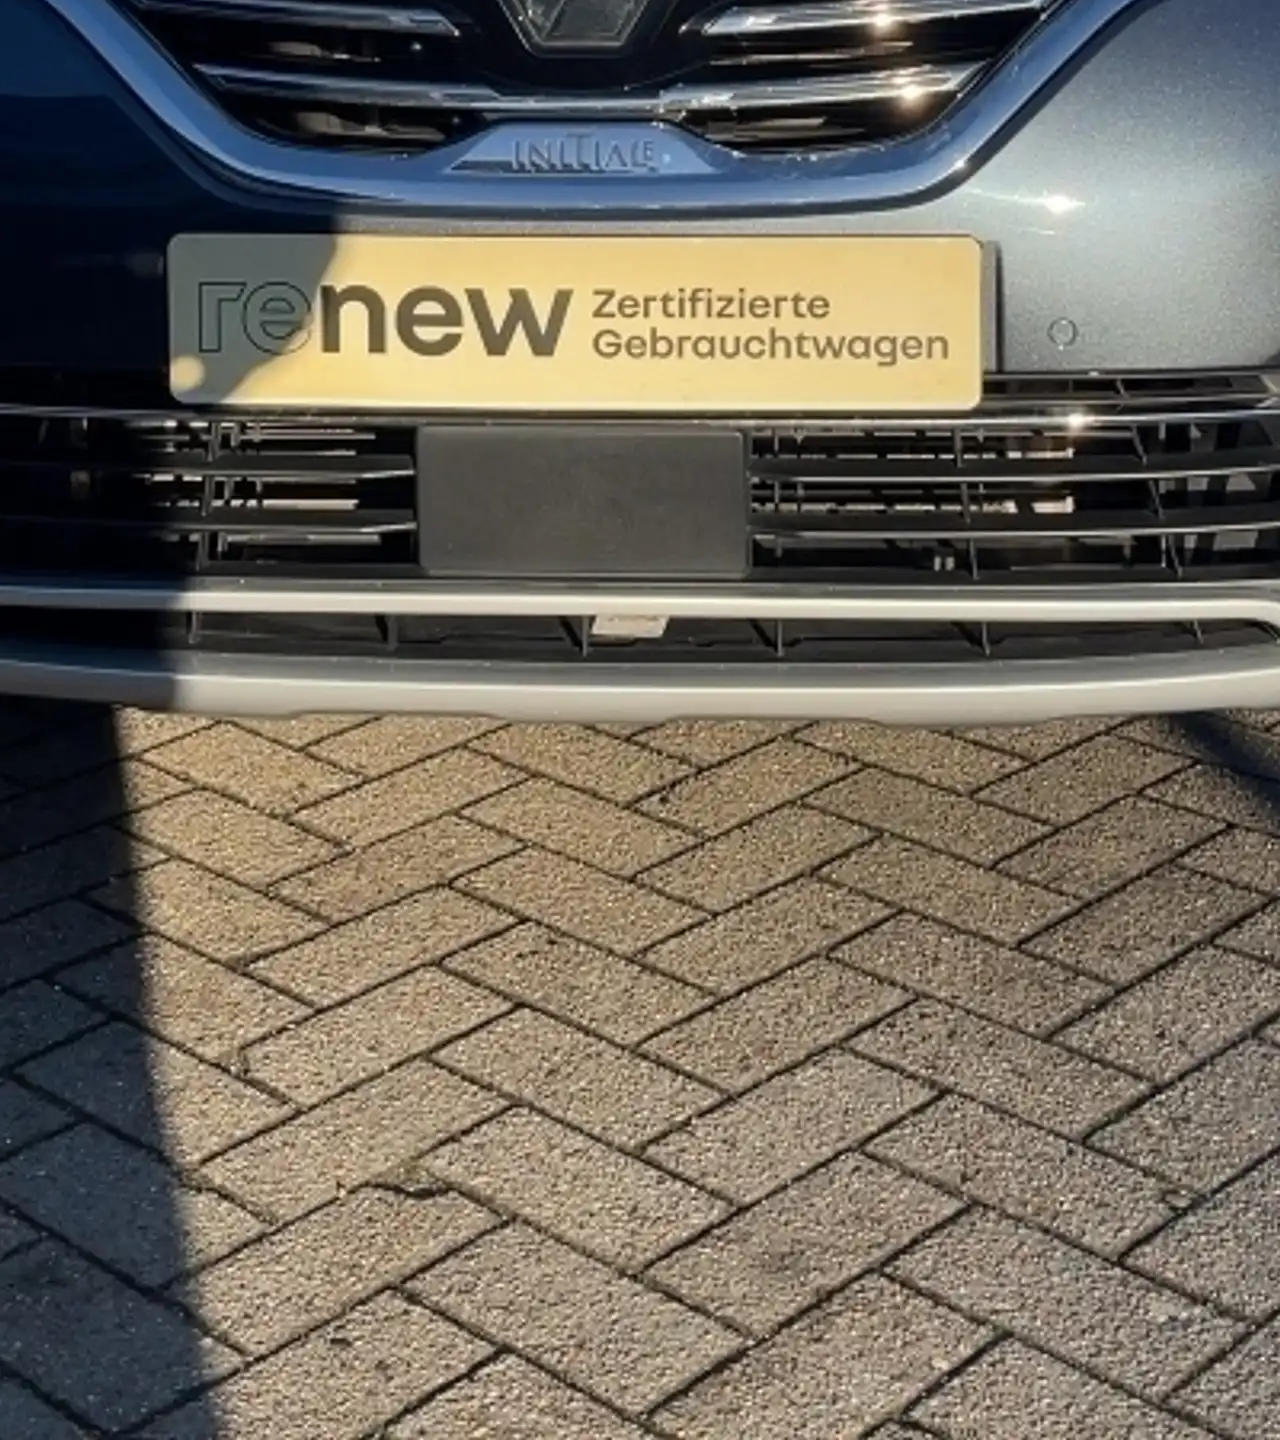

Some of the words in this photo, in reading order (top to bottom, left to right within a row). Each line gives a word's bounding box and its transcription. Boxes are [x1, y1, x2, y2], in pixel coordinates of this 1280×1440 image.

[198, 281, 574, 357] renew
[592, 288, 831, 319] Zertifizierte
[592, 327, 950, 367] Gebrauchtwagen
